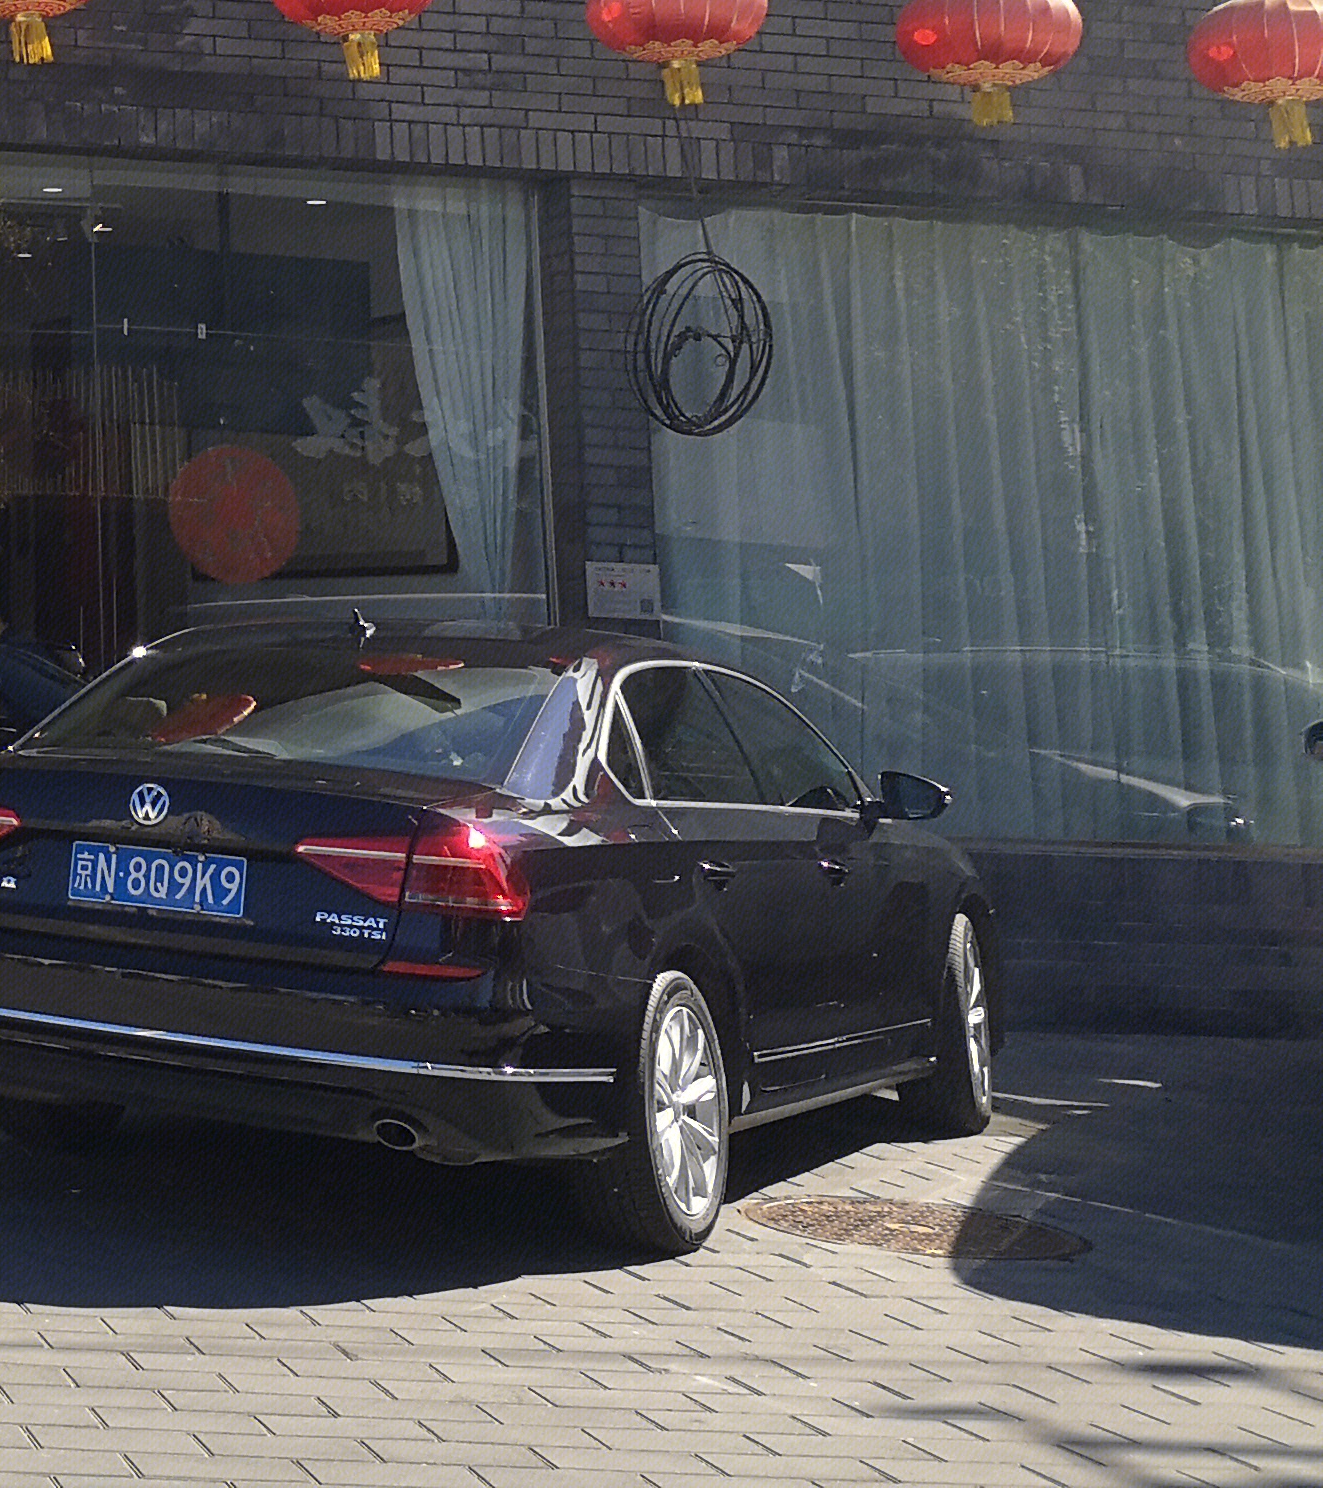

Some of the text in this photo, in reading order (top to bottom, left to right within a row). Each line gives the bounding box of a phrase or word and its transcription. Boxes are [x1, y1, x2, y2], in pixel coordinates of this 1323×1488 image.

[315, 911, 389, 929] PASSAT
[331, 925, 387, 941] 330 TSI
